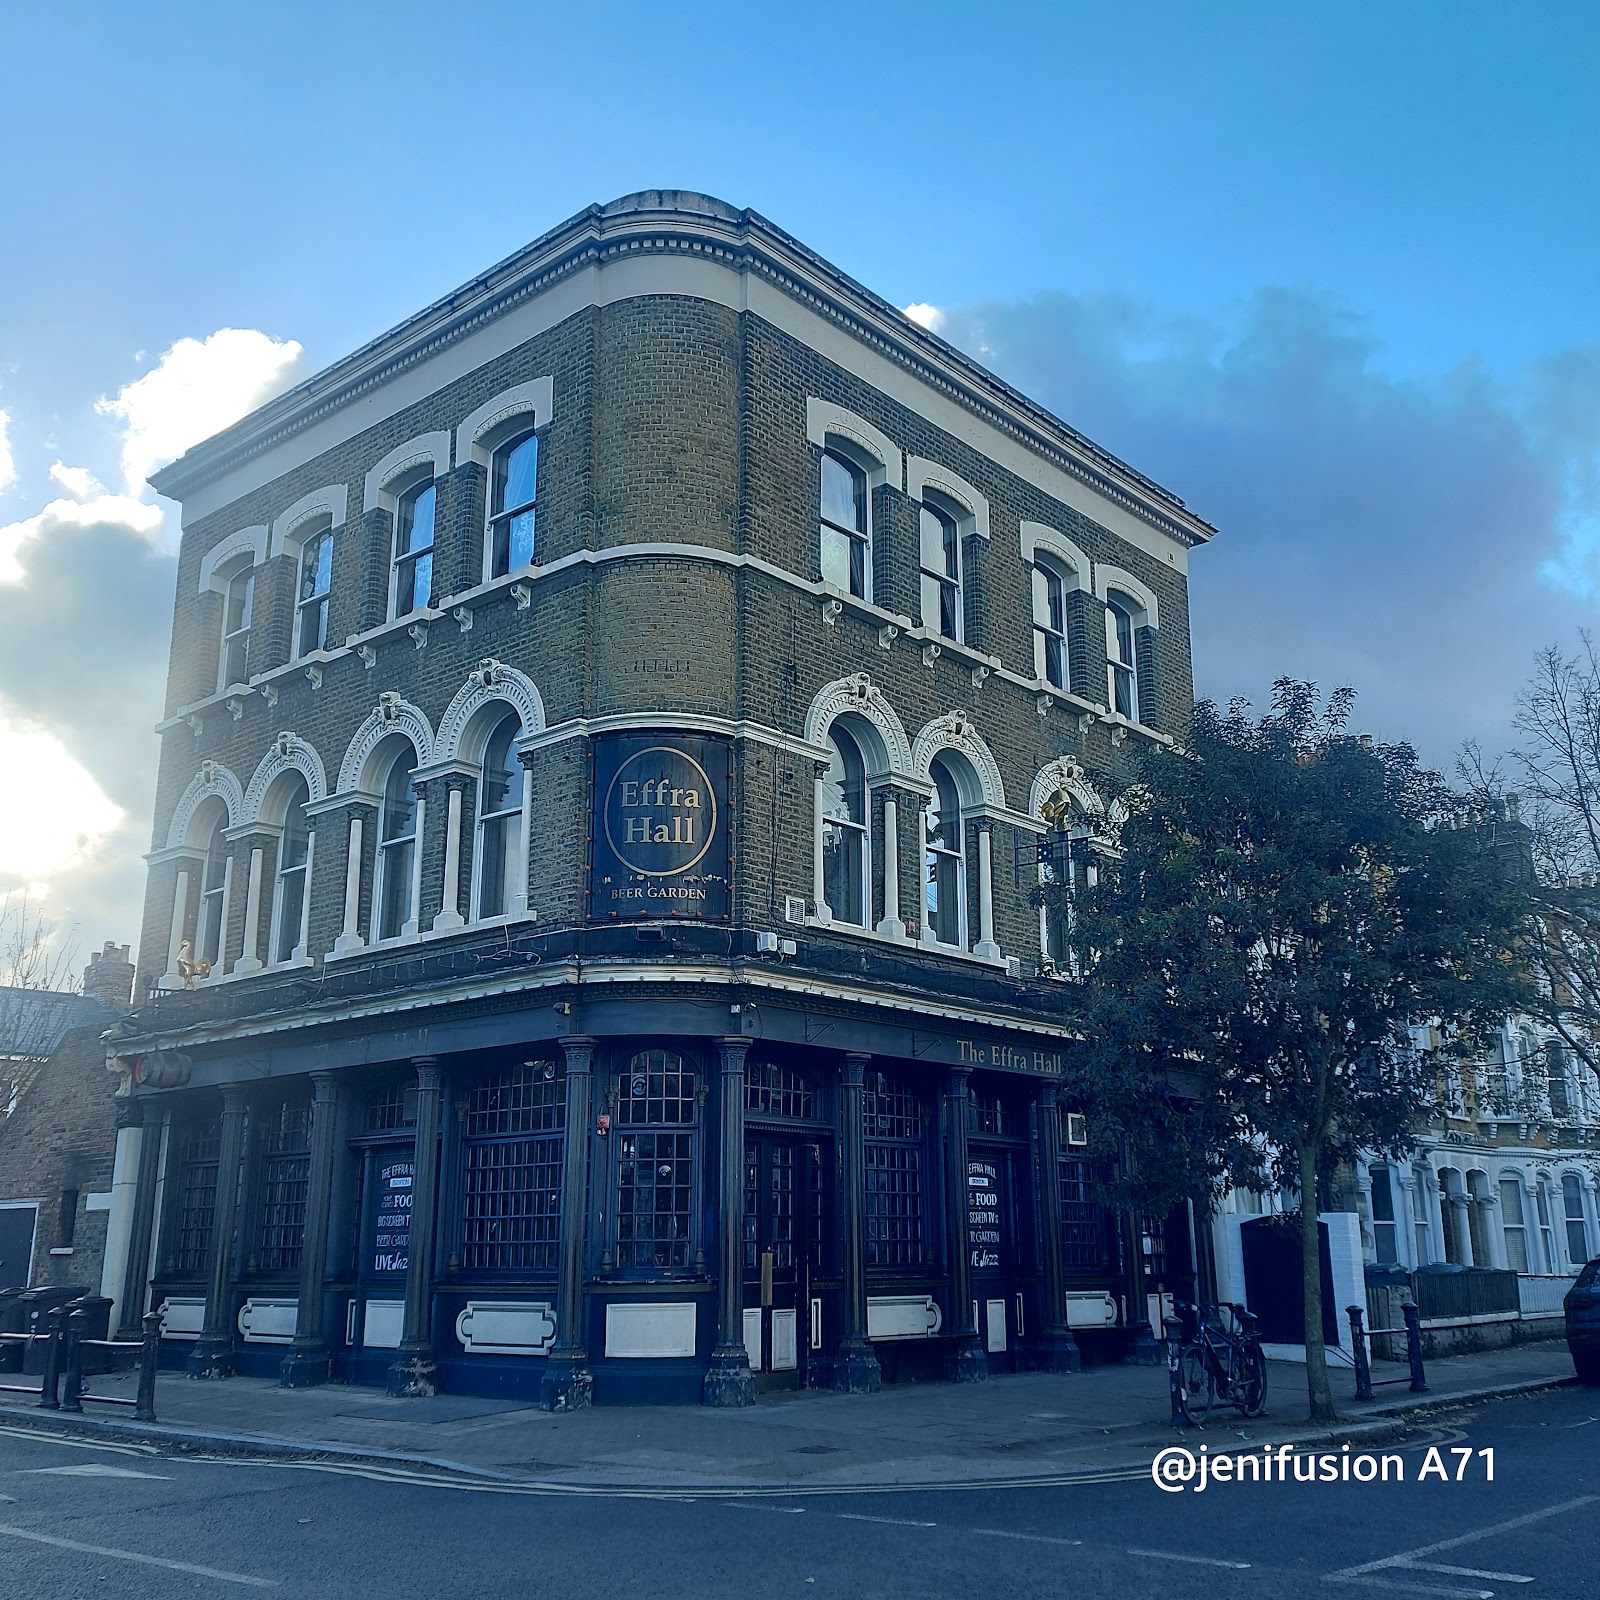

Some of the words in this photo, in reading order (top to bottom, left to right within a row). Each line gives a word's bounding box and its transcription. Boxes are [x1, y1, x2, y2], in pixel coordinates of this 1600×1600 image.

[620, 778, 701, 809] Effra
[623, 816, 696, 844] Hall
[611, 887, 643, 900] BEER
[647, 887, 707, 900] GARDEN
[956, 1039, 986, 1064] The
[991, 1045, 1027, 1070] Effra
[1032, 1051, 1061, 1074] Hall
[392, 1164, 408, 1176] EFFRA
[975, 1192, 998, 1206] FOOD
[376, 1234, 391, 1247] BEER
[976, 1231, 999, 1243] GARDEN
[375, 1254, 393, 1271] LIVE
